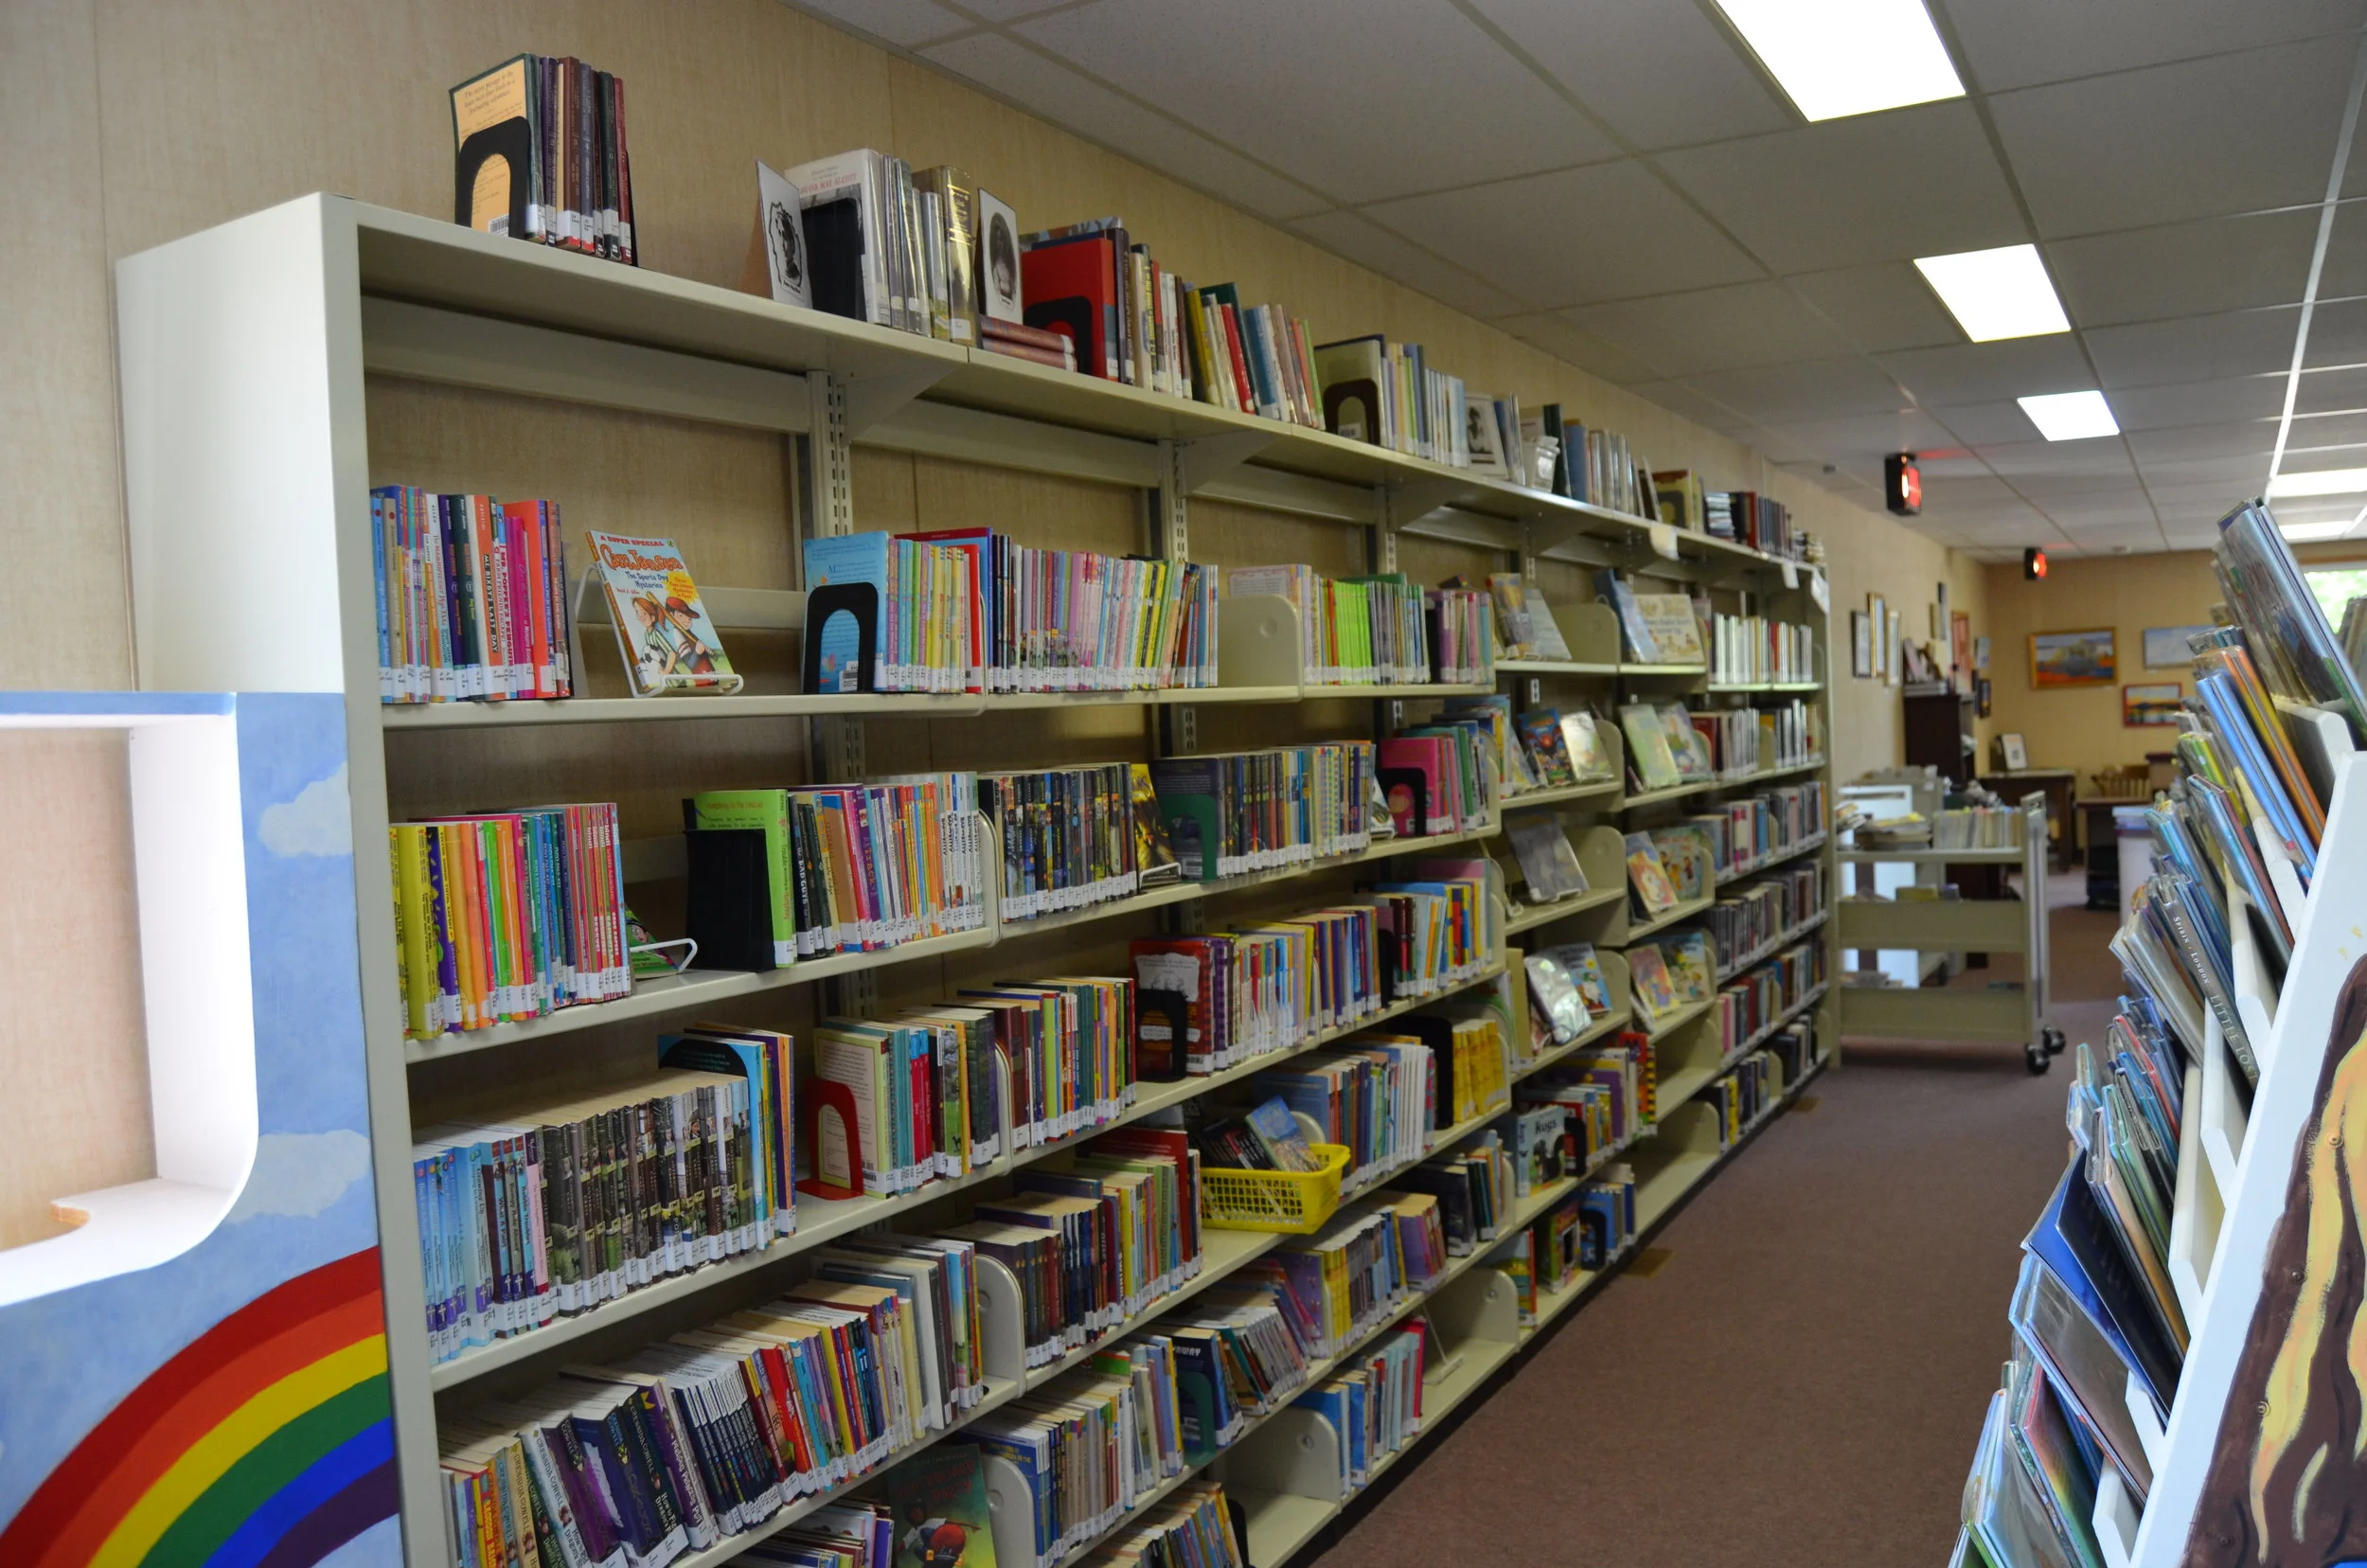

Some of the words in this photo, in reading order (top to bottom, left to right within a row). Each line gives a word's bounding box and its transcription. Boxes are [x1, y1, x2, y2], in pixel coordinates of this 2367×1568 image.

[801, 183, 818, 194] OUISA
[607, 536, 631, 544] SUPER
[600, 544, 631, 570] Cam
[629, 550, 685, 571] Jansen
[485, 570, 494, 603] BIXBY'S
[625, 571, 636, 579] The
[638, 572, 656, 581] Sports
[658, 574, 668, 582] Day
[635, 580, 663, 589] Mysteries
[502, 572, 512, 618] POPPER'S
[488, 606, 496, 630] LAST
[506, 621, 514, 667] PENGUIN
[2191, 952, 2211, 985] LONDON
[2210, 993, 2240, 1043] LITTLE
[2234, 1046, 2260, 1081] LOST
[478, 1203, 484, 1214] Up
[772, 1414, 781, 1430] BFG
[561, 1424, 574, 1454] COWELL
[630, 1406, 647, 1445] CRESSIDA
[642, 1443, 655, 1473] COWELL
[514, 1454, 525, 1497] CRESSIDA
[536, 1438, 552, 1476] CRESSIDA
[550, 1476, 563, 1507] COWELL
[498, 1462, 507, 1504] CRESSIDA
[503, 1504, 513, 1540] COWELL
[528, 1486, 543, 1518] COWELL
[655, 1496, 668, 1527] Dragon's
[661, 1492, 670, 1508] How
[519, 1498, 529, 1533] COWELL
[564, 1529, 578, 1559] Dragon's
[571, 1529, 580, 1543] How
